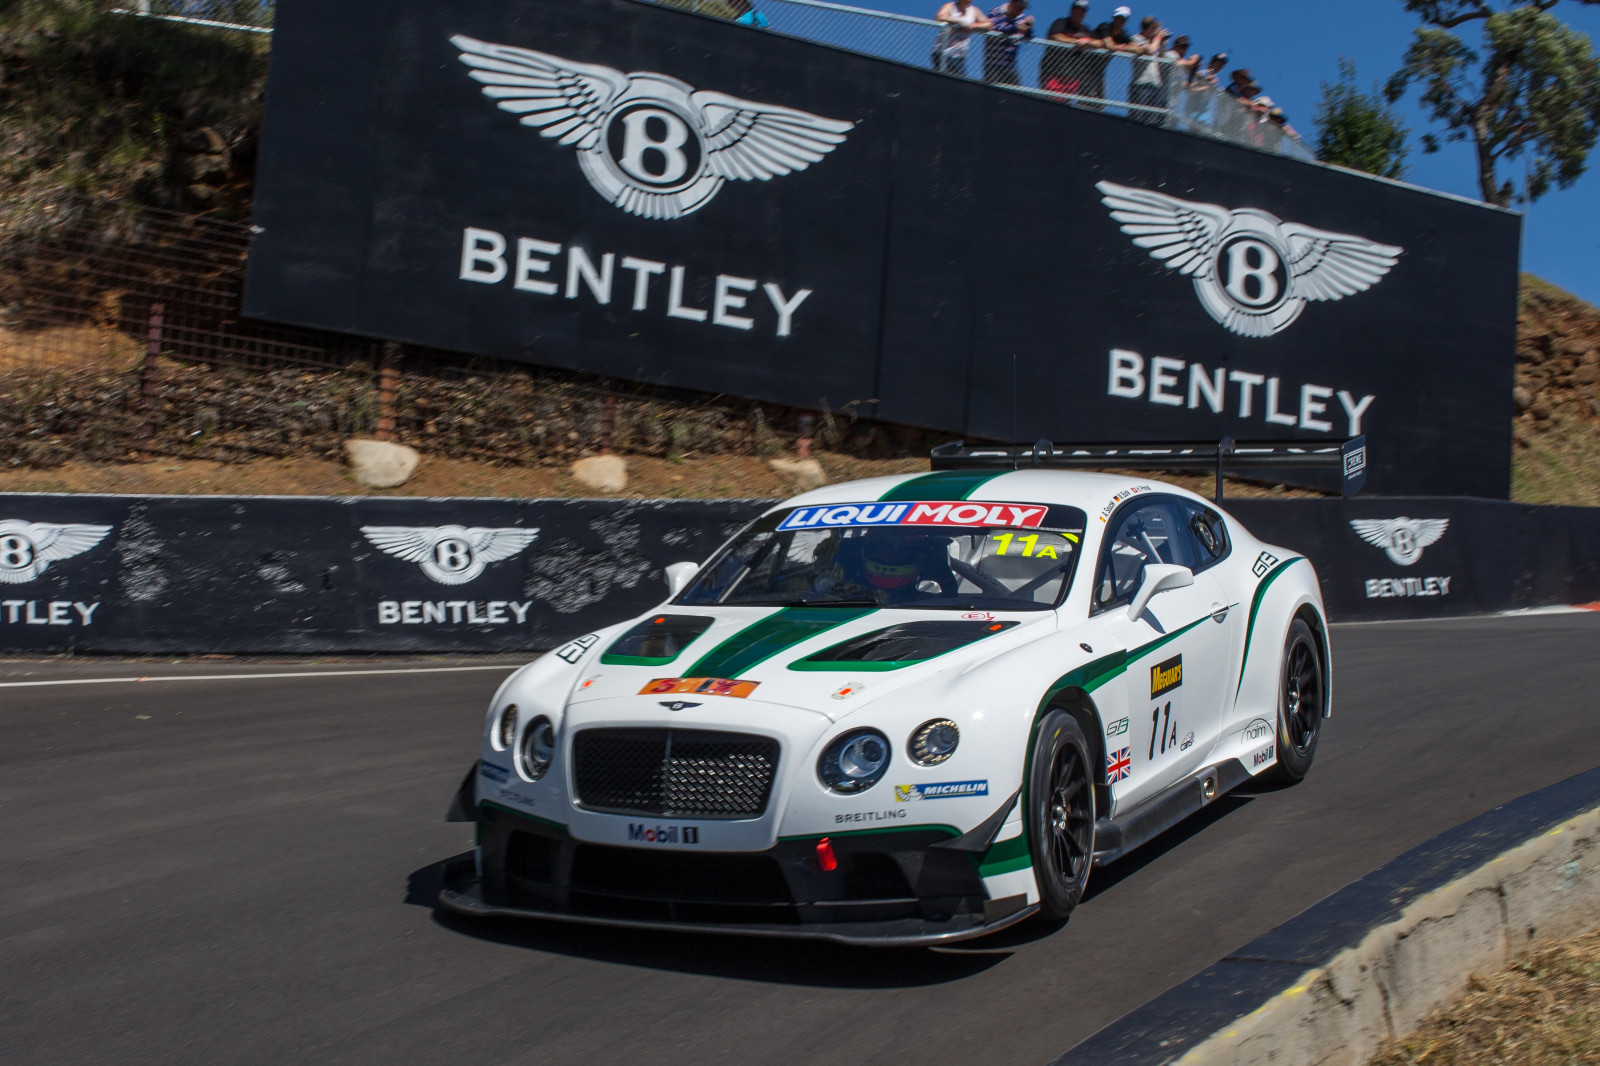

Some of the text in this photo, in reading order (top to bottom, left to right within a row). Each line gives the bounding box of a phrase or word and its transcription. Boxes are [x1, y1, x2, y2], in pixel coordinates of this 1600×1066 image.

[459, 226, 813, 337] BENTLEY
[1107, 348, 1376, 437] BENTLEY
[785, 504, 1045, 528] LIQUI MOLY
[992, 532, 1058, 560] 11A
[1364, 576, 1453, 599] BENTLEY
[0, 599, 101, 627] TLEY
[377, 600, 534, 625] BENTLEY
[1148, 700, 1177, 761] 11A
[1246, 724, 1267, 741] naim
[1252, 747, 1269, 767] Mobil
[924, 782, 988, 796] MICHELIN
[834, 808, 907, 824] BREITLING
[627, 822, 679, 844] Mobil
